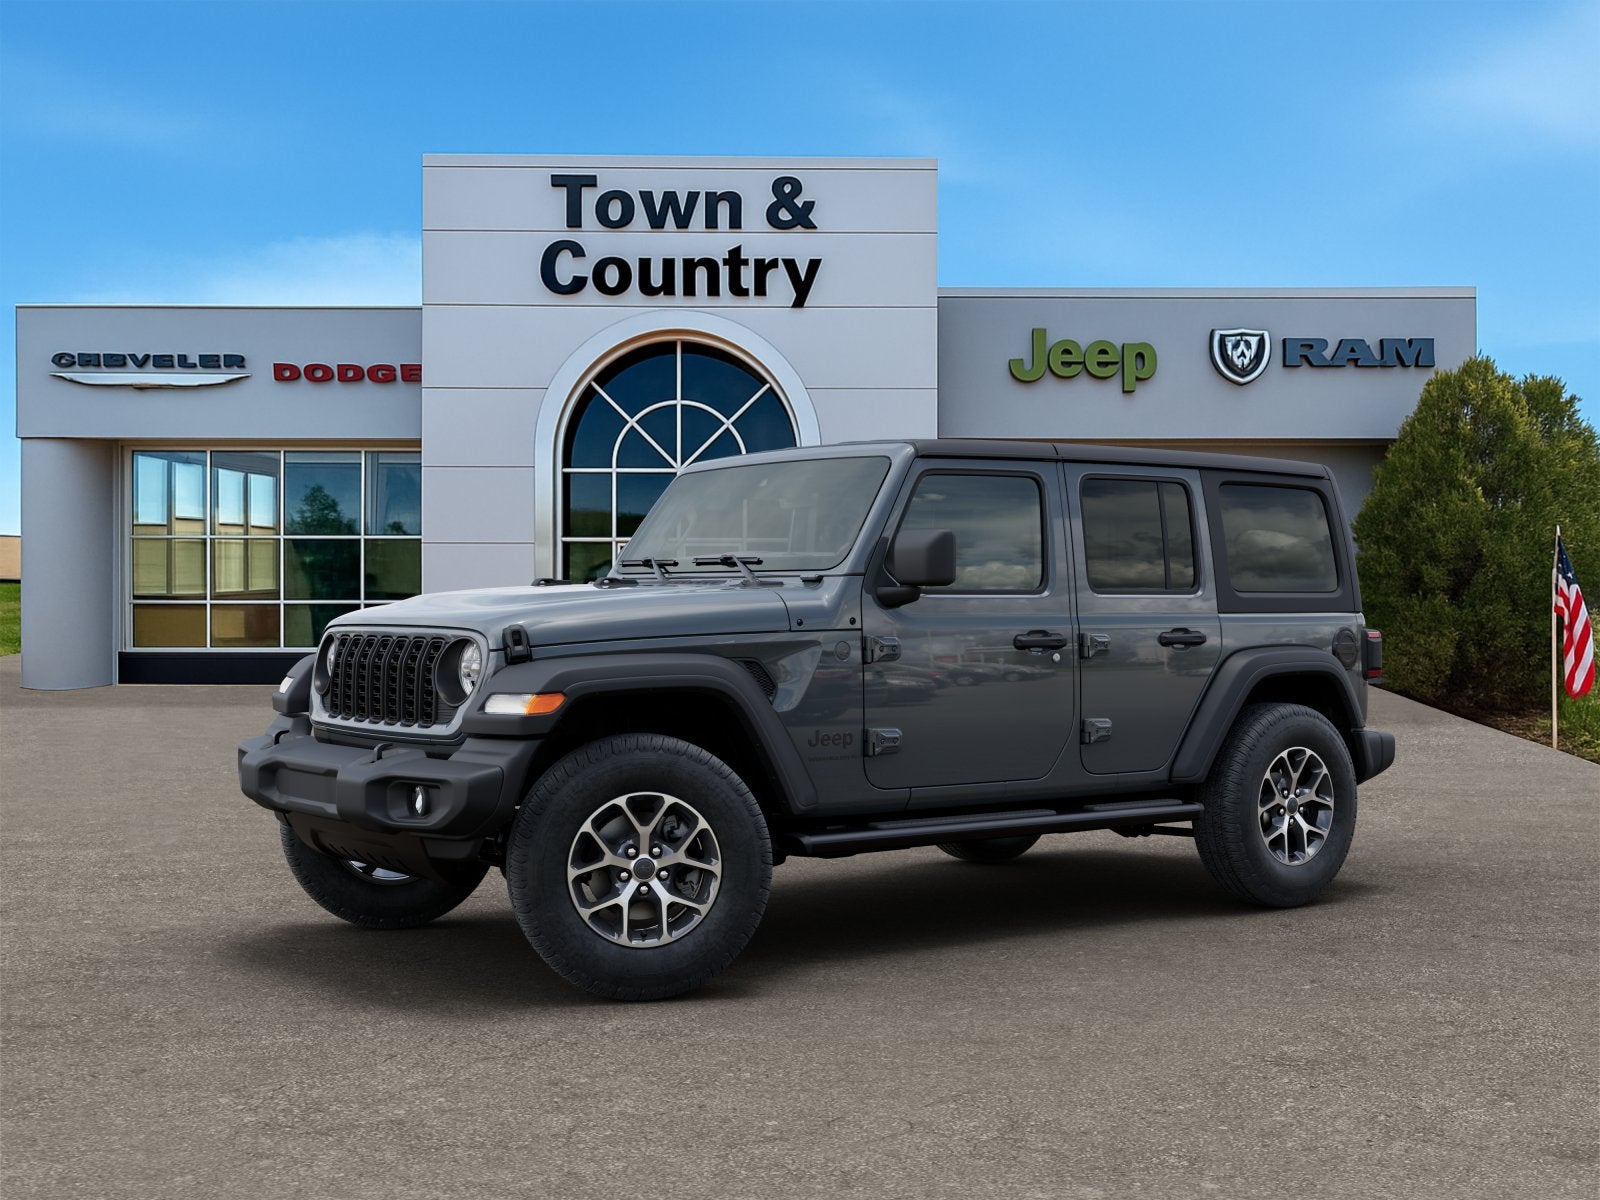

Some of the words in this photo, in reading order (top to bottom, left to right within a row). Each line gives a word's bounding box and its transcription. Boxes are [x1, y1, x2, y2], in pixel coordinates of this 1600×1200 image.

[550, 173, 743, 230] Town
[765, 176, 818, 230] &
[540, 239, 823, 308] Country
[272, 362, 422, 383] DODGE
[1009, 327, 1158, 393] Jeep
[1282, 337, 1435, 368] RAM
[808, 729, 853, 749] Jeep
